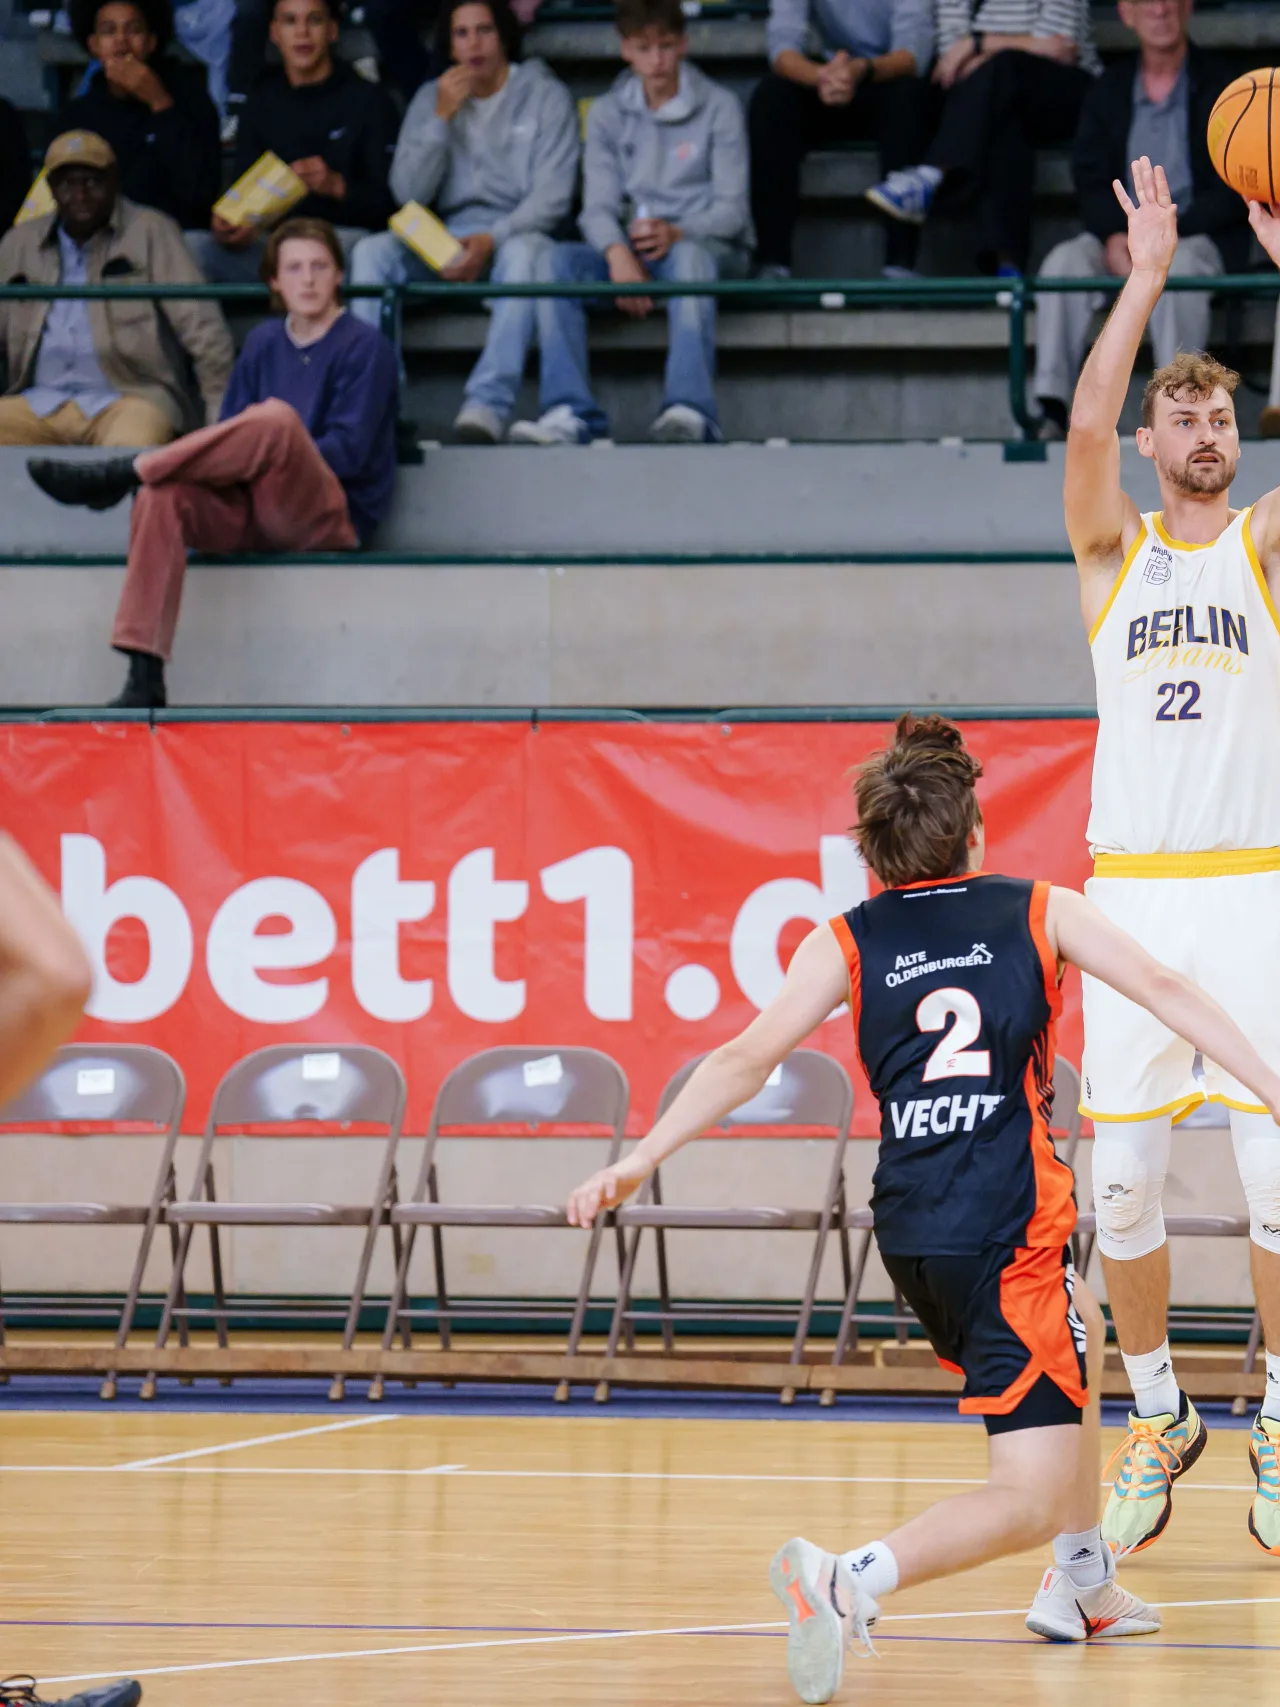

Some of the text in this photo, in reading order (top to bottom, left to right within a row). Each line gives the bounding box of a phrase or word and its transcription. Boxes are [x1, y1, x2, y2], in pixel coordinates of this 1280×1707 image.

[1126, 604, 1249, 662] BERLIN
[1155, 680, 1202, 721] 22
[885, 954, 984, 988] OLDENBURGER
[916, 987, 990, 1082] 2
